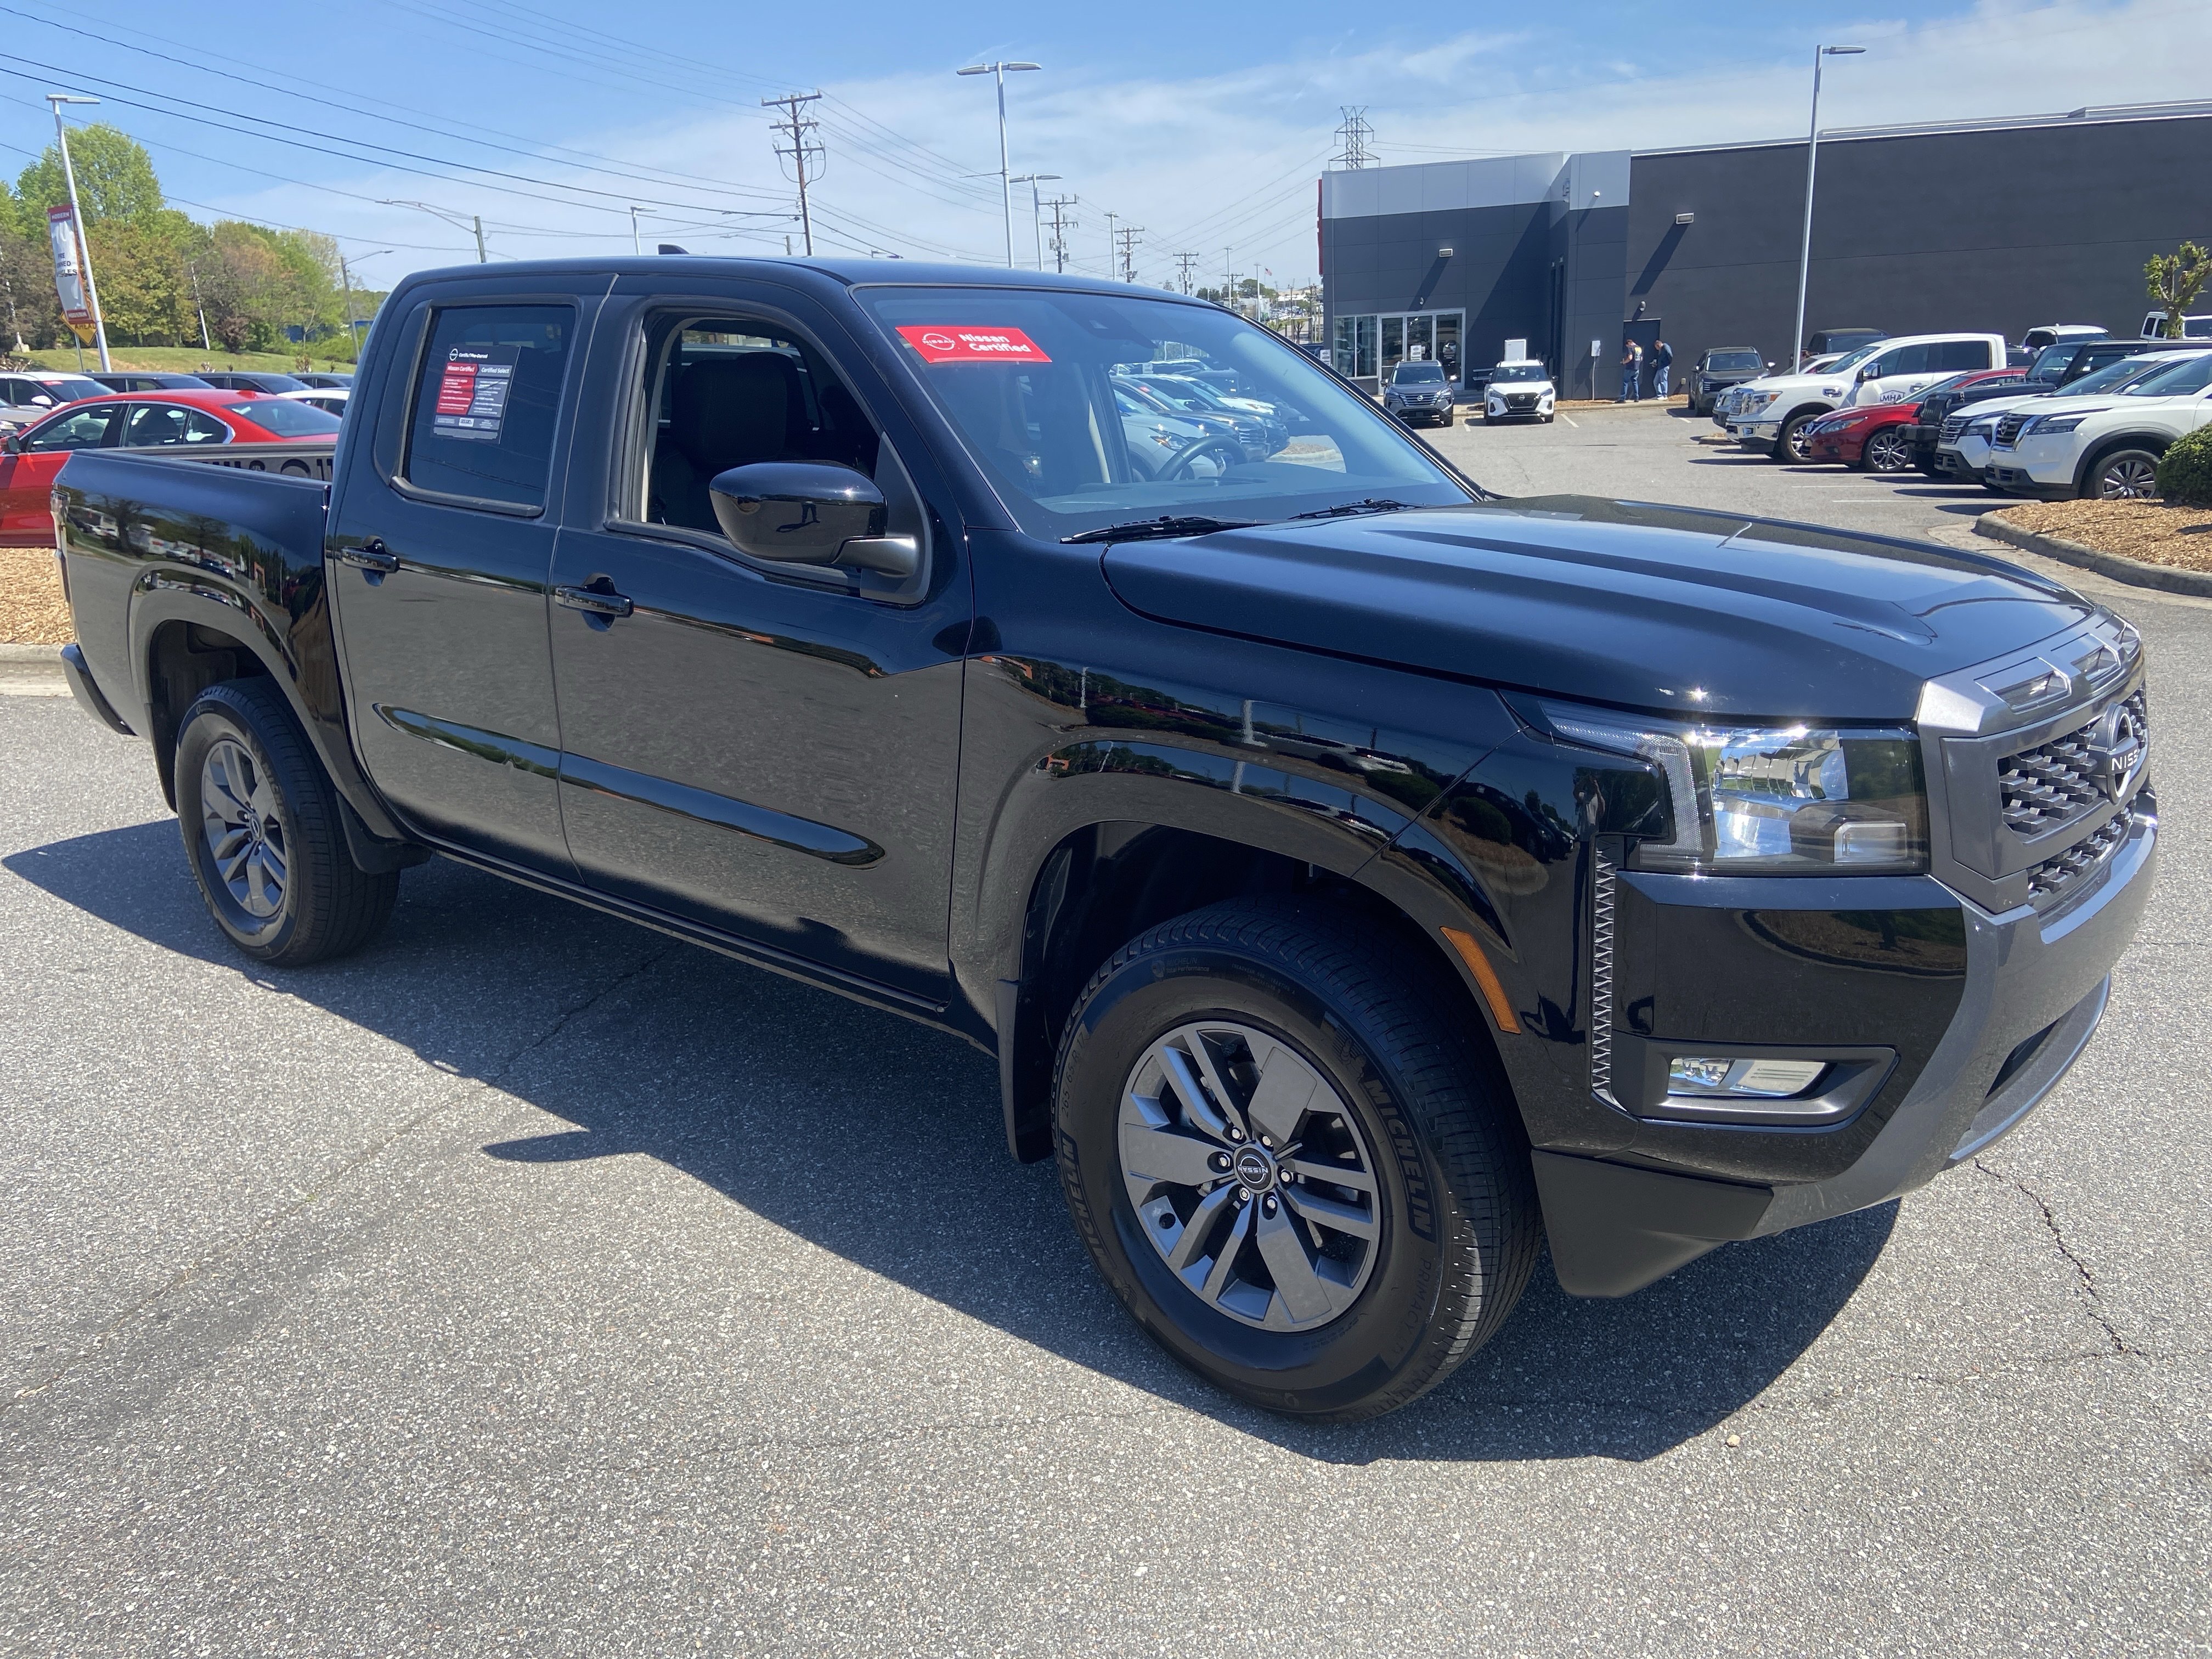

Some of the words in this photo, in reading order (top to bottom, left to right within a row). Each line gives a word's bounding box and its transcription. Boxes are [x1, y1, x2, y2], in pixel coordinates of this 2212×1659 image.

[958, 334, 1010, 343] Nissan
[969, 343, 1032, 352] Certified
[2112, 749, 2139, 771] NISS
[1364, 1079, 1431, 1233] MICHELIN
[1062, 1136, 1110, 1267] MICHELIN
[1404, 1257, 1432, 1333] PRIMACY
